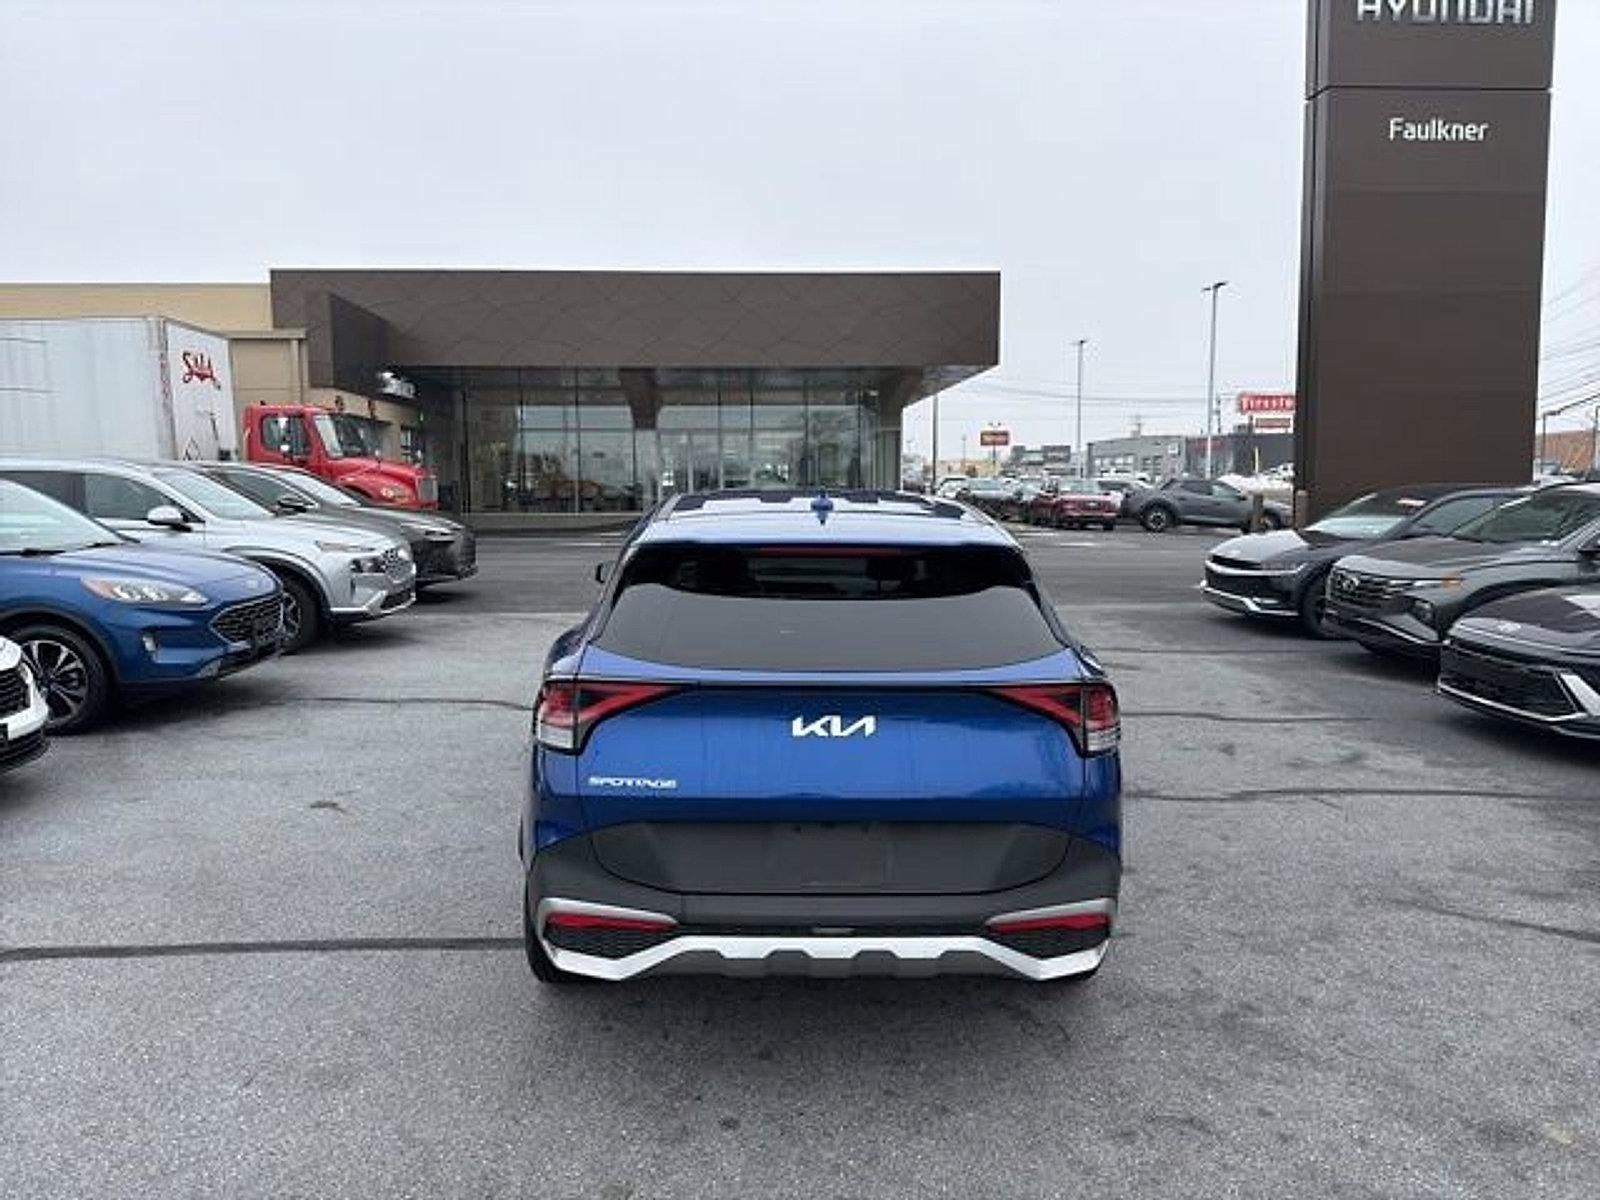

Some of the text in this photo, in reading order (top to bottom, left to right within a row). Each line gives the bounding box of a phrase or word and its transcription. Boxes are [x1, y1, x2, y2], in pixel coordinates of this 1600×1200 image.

[1356, 0, 1535, 23] HYUNDAI
[1389, 118, 1489, 141] Faulkner
[792, 715, 876, 737] KIA
